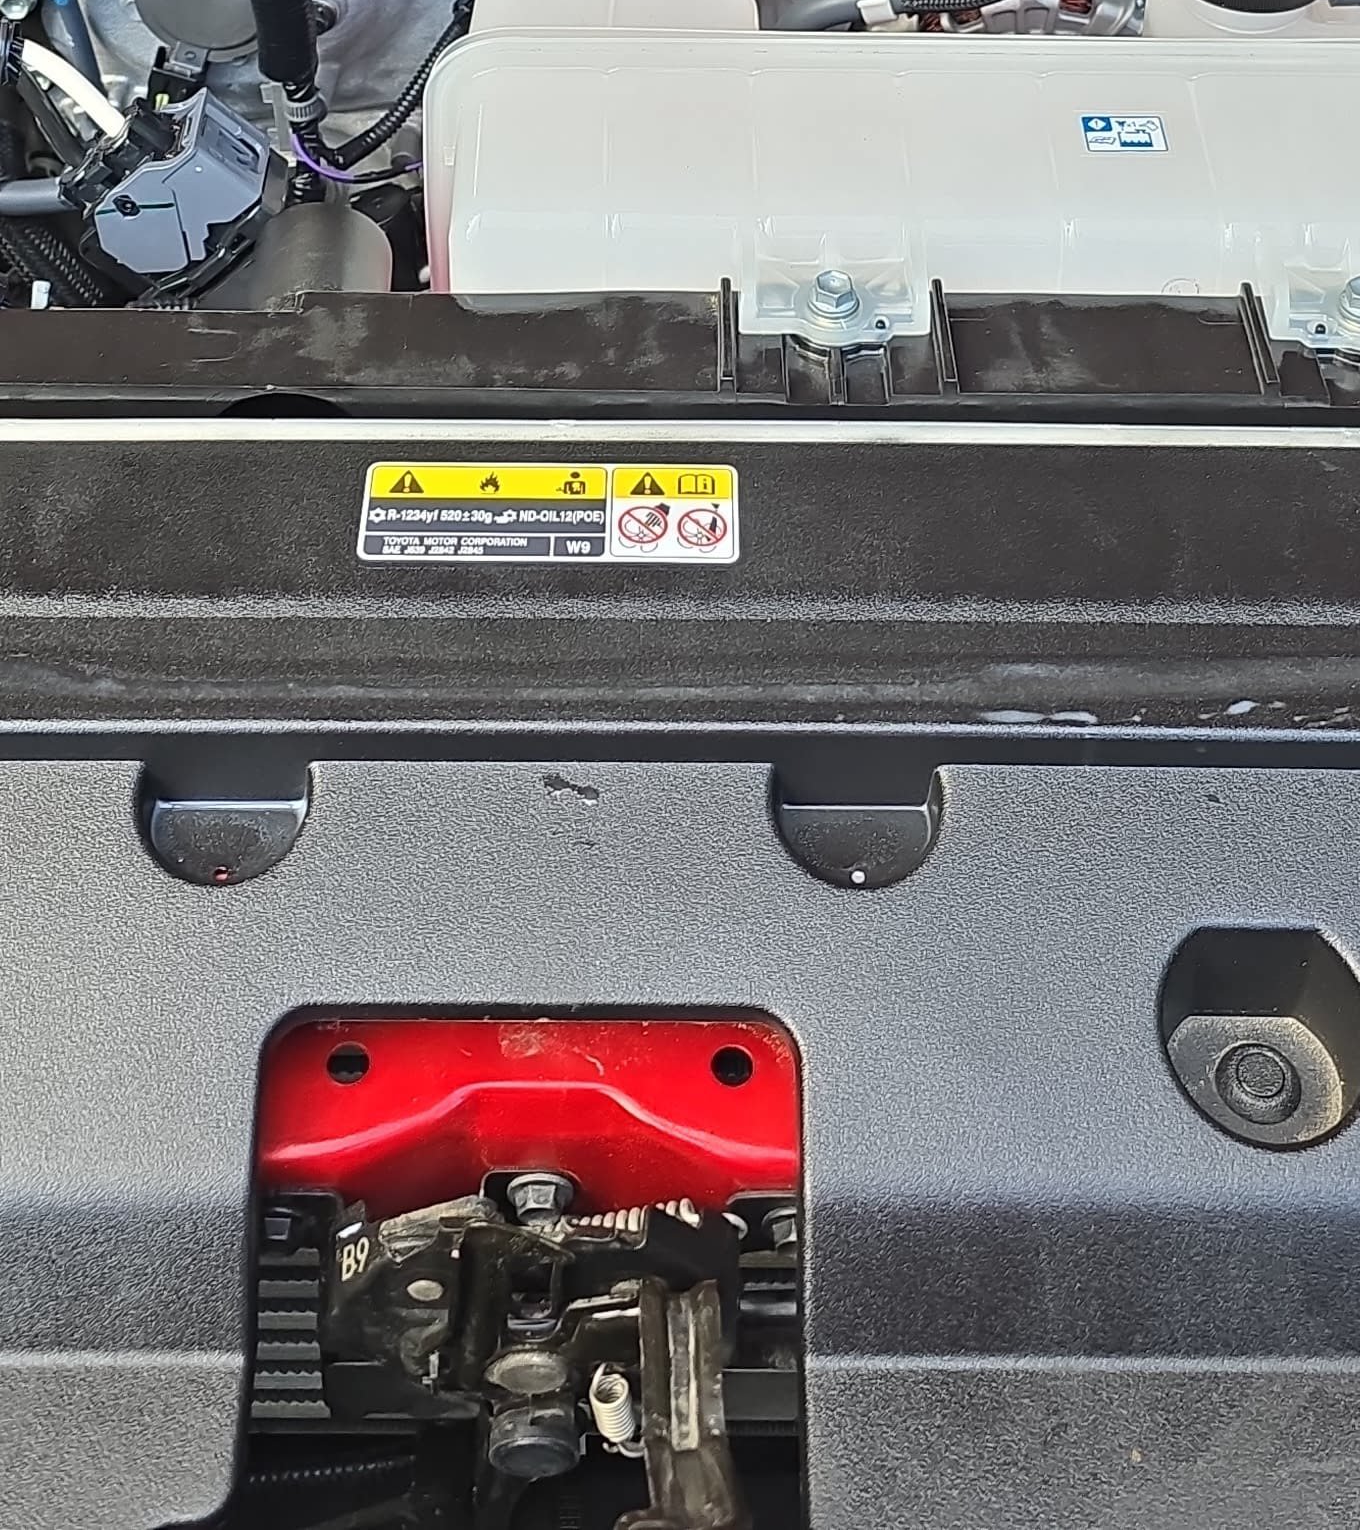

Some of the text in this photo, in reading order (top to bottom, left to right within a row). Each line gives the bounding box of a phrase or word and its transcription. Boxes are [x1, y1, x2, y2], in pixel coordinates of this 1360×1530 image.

[387, 509, 604, 524] R-1234yf 520±30g ND-OIL12(POE)
[383, 537, 528, 547] TOYOTA MOTOR CORPORATION
[566, 540, 591, 554] W9
[341, 1236, 370, 1282] B9
